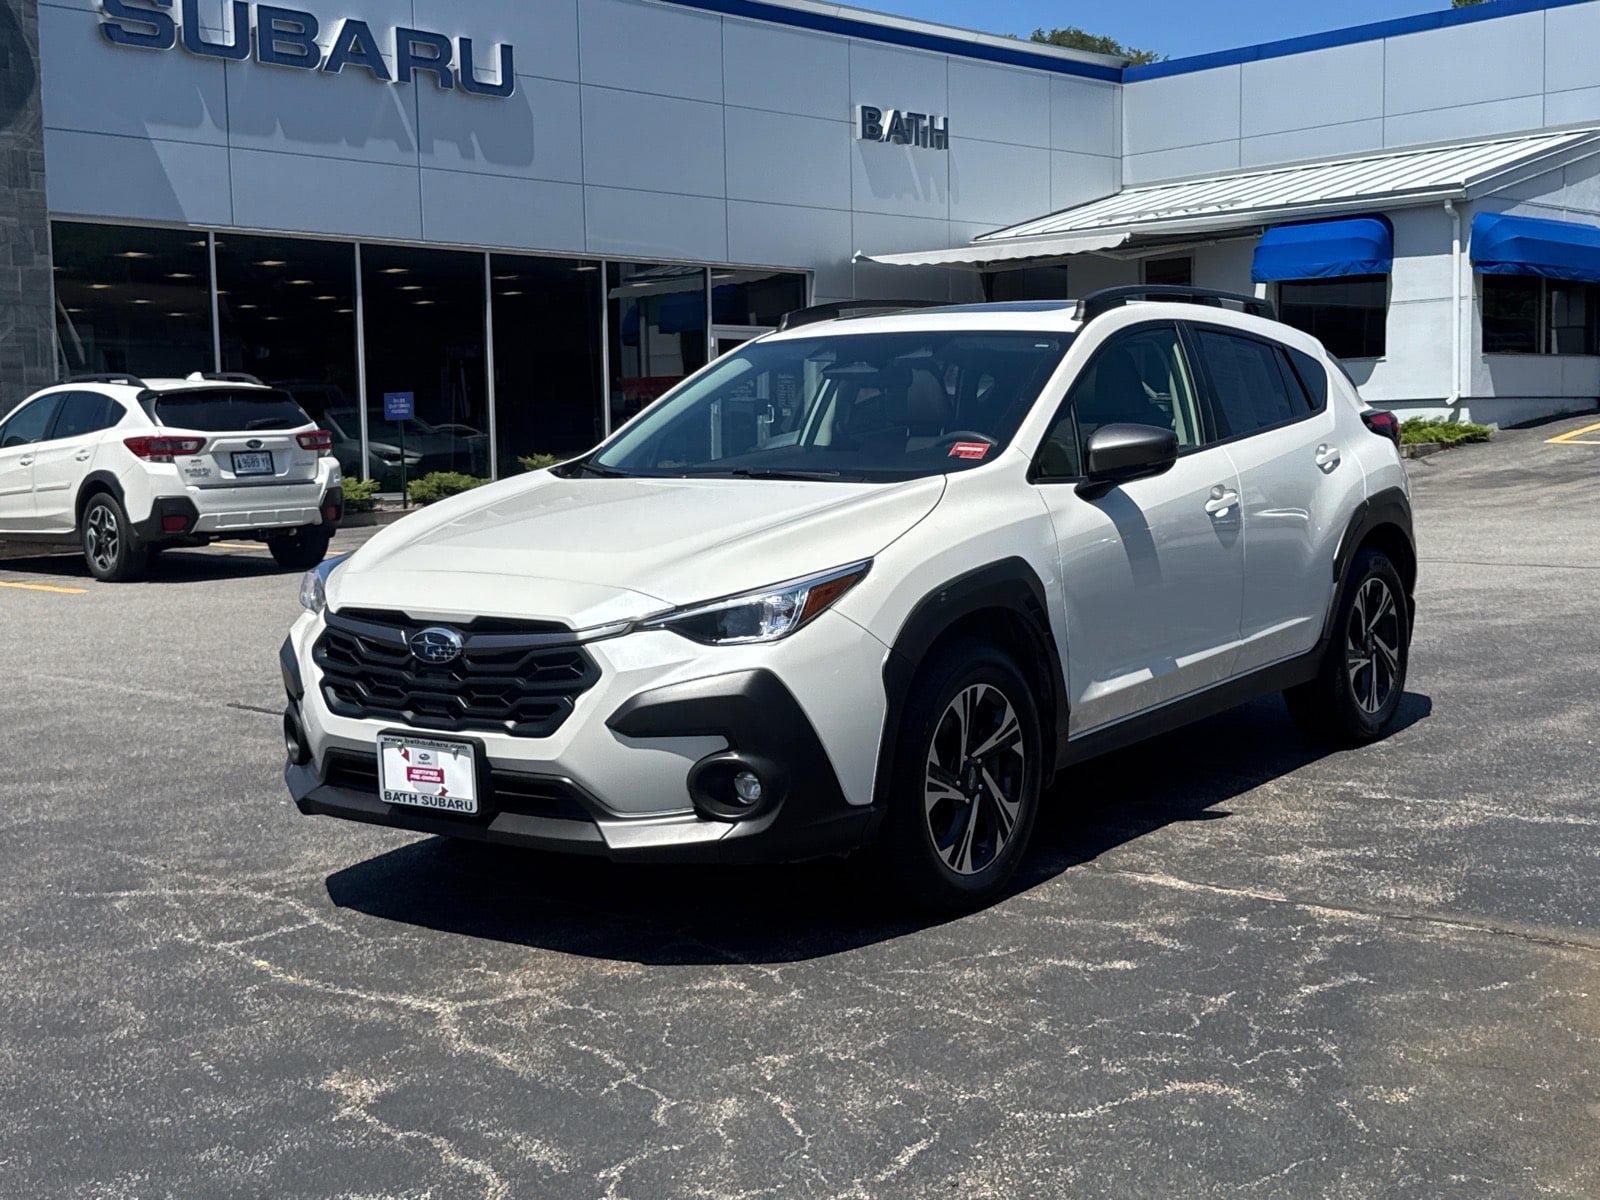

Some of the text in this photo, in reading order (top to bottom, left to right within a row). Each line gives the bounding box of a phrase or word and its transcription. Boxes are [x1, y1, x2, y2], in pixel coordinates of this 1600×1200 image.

[99, 0, 515, 99] SUBARU
[857, 104, 949, 150] BATH
[384, 791, 473, 812] BATH SUBARU
